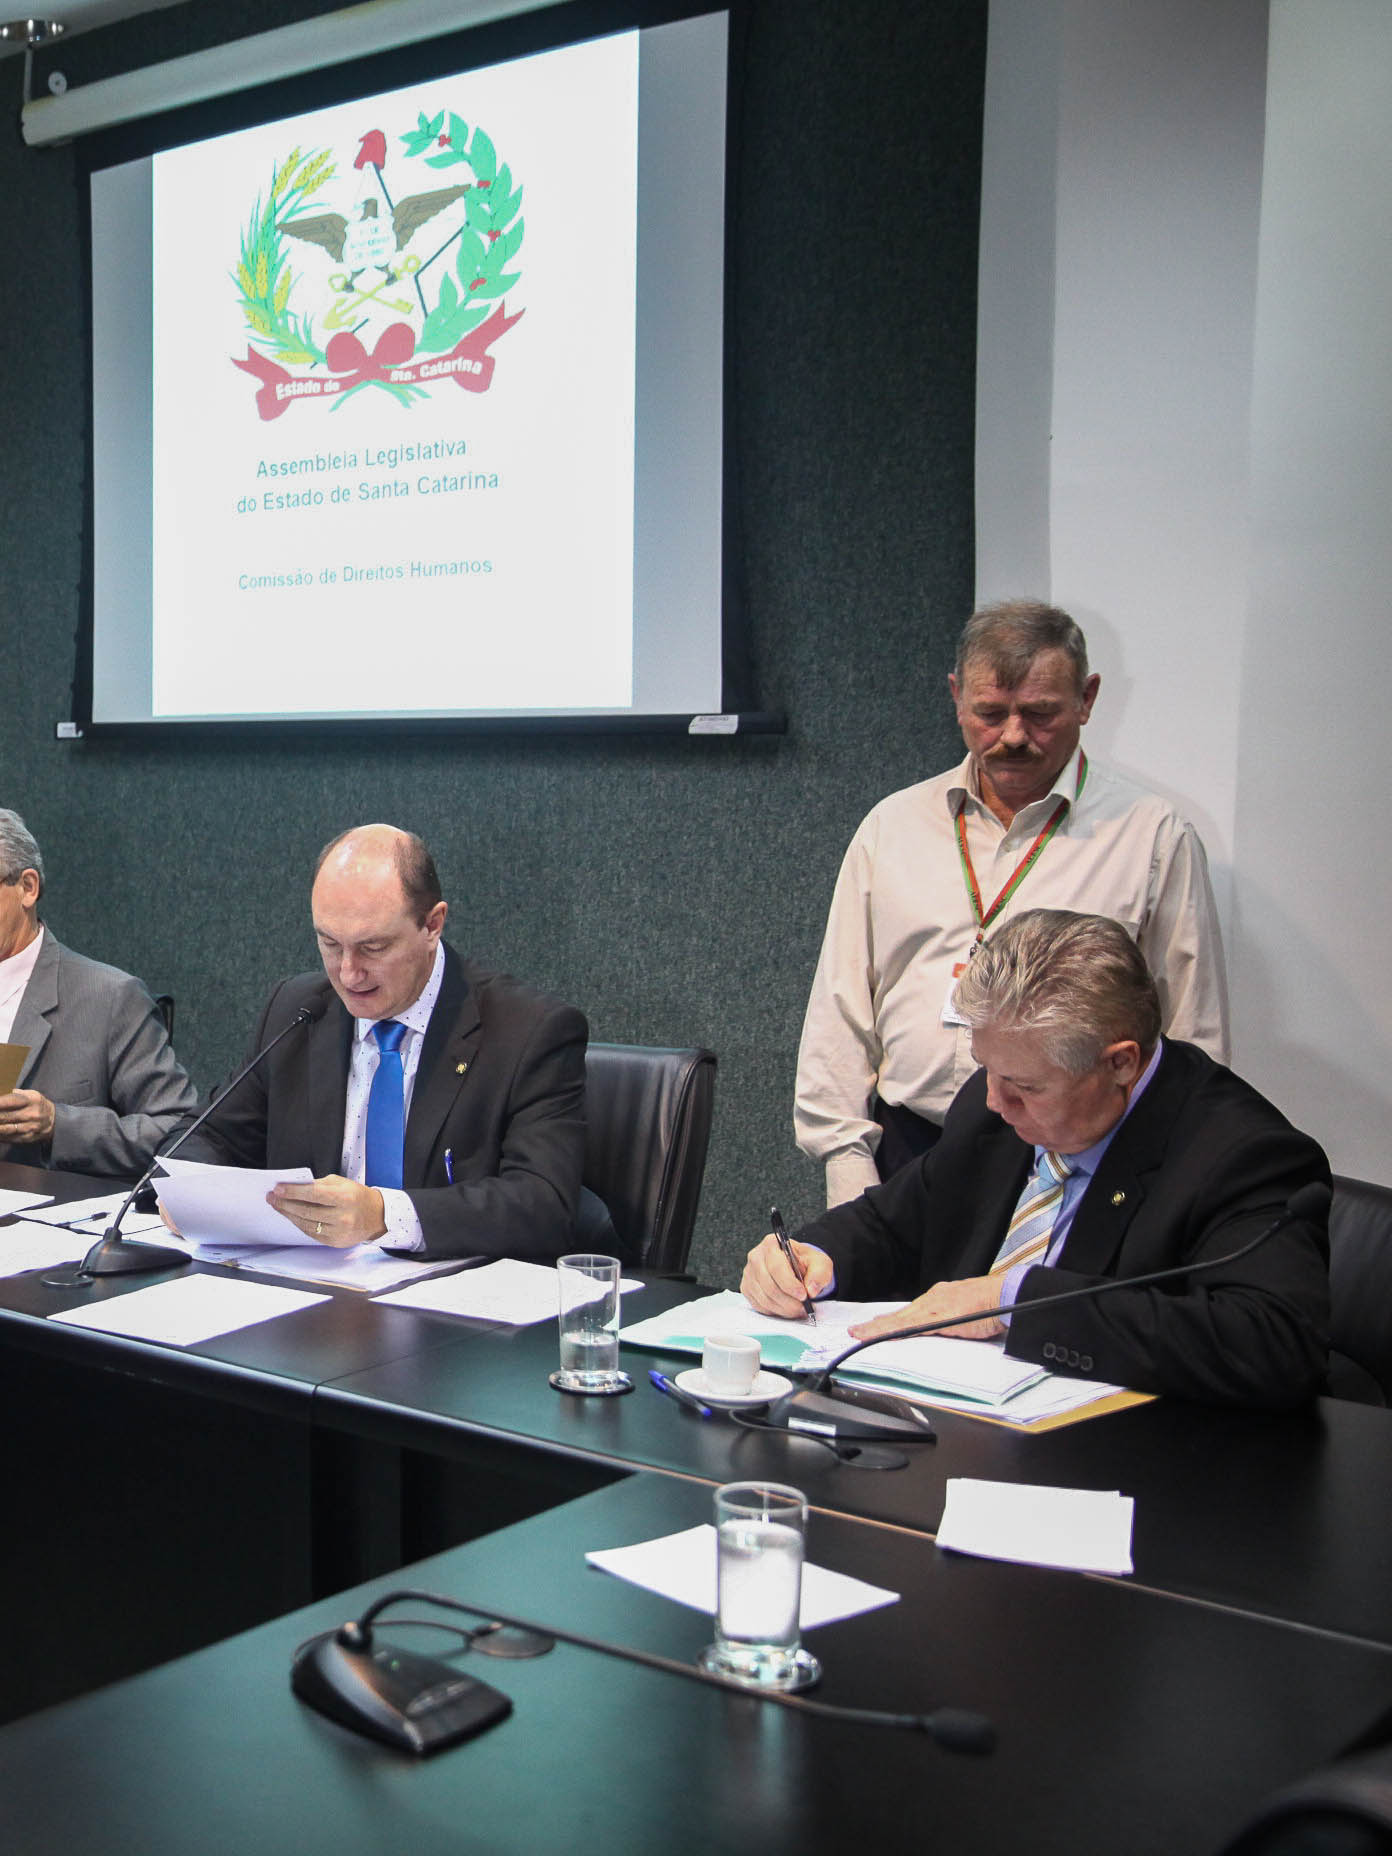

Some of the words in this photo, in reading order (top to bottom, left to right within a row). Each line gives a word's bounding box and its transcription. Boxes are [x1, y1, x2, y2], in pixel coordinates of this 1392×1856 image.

[275, 380, 321, 400] Estado
[419, 356, 484, 377] Catarina
[256, 450, 358, 478] Assembleia
[365, 439, 467, 469] Legislativa
[236, 496, 257, 514] do
[263, 489, 324, 511] Estado
[330, 486, 351, 504] de
[358, 478, 410, 501] Santa
[417, 471, 499, 496] Catarina
[238, 568, 313, 590] Comissão
[319, 568, 337, 585] de
[343, 562, 404, 582] Direitos
[410, 557, 493, 579] Humanos
